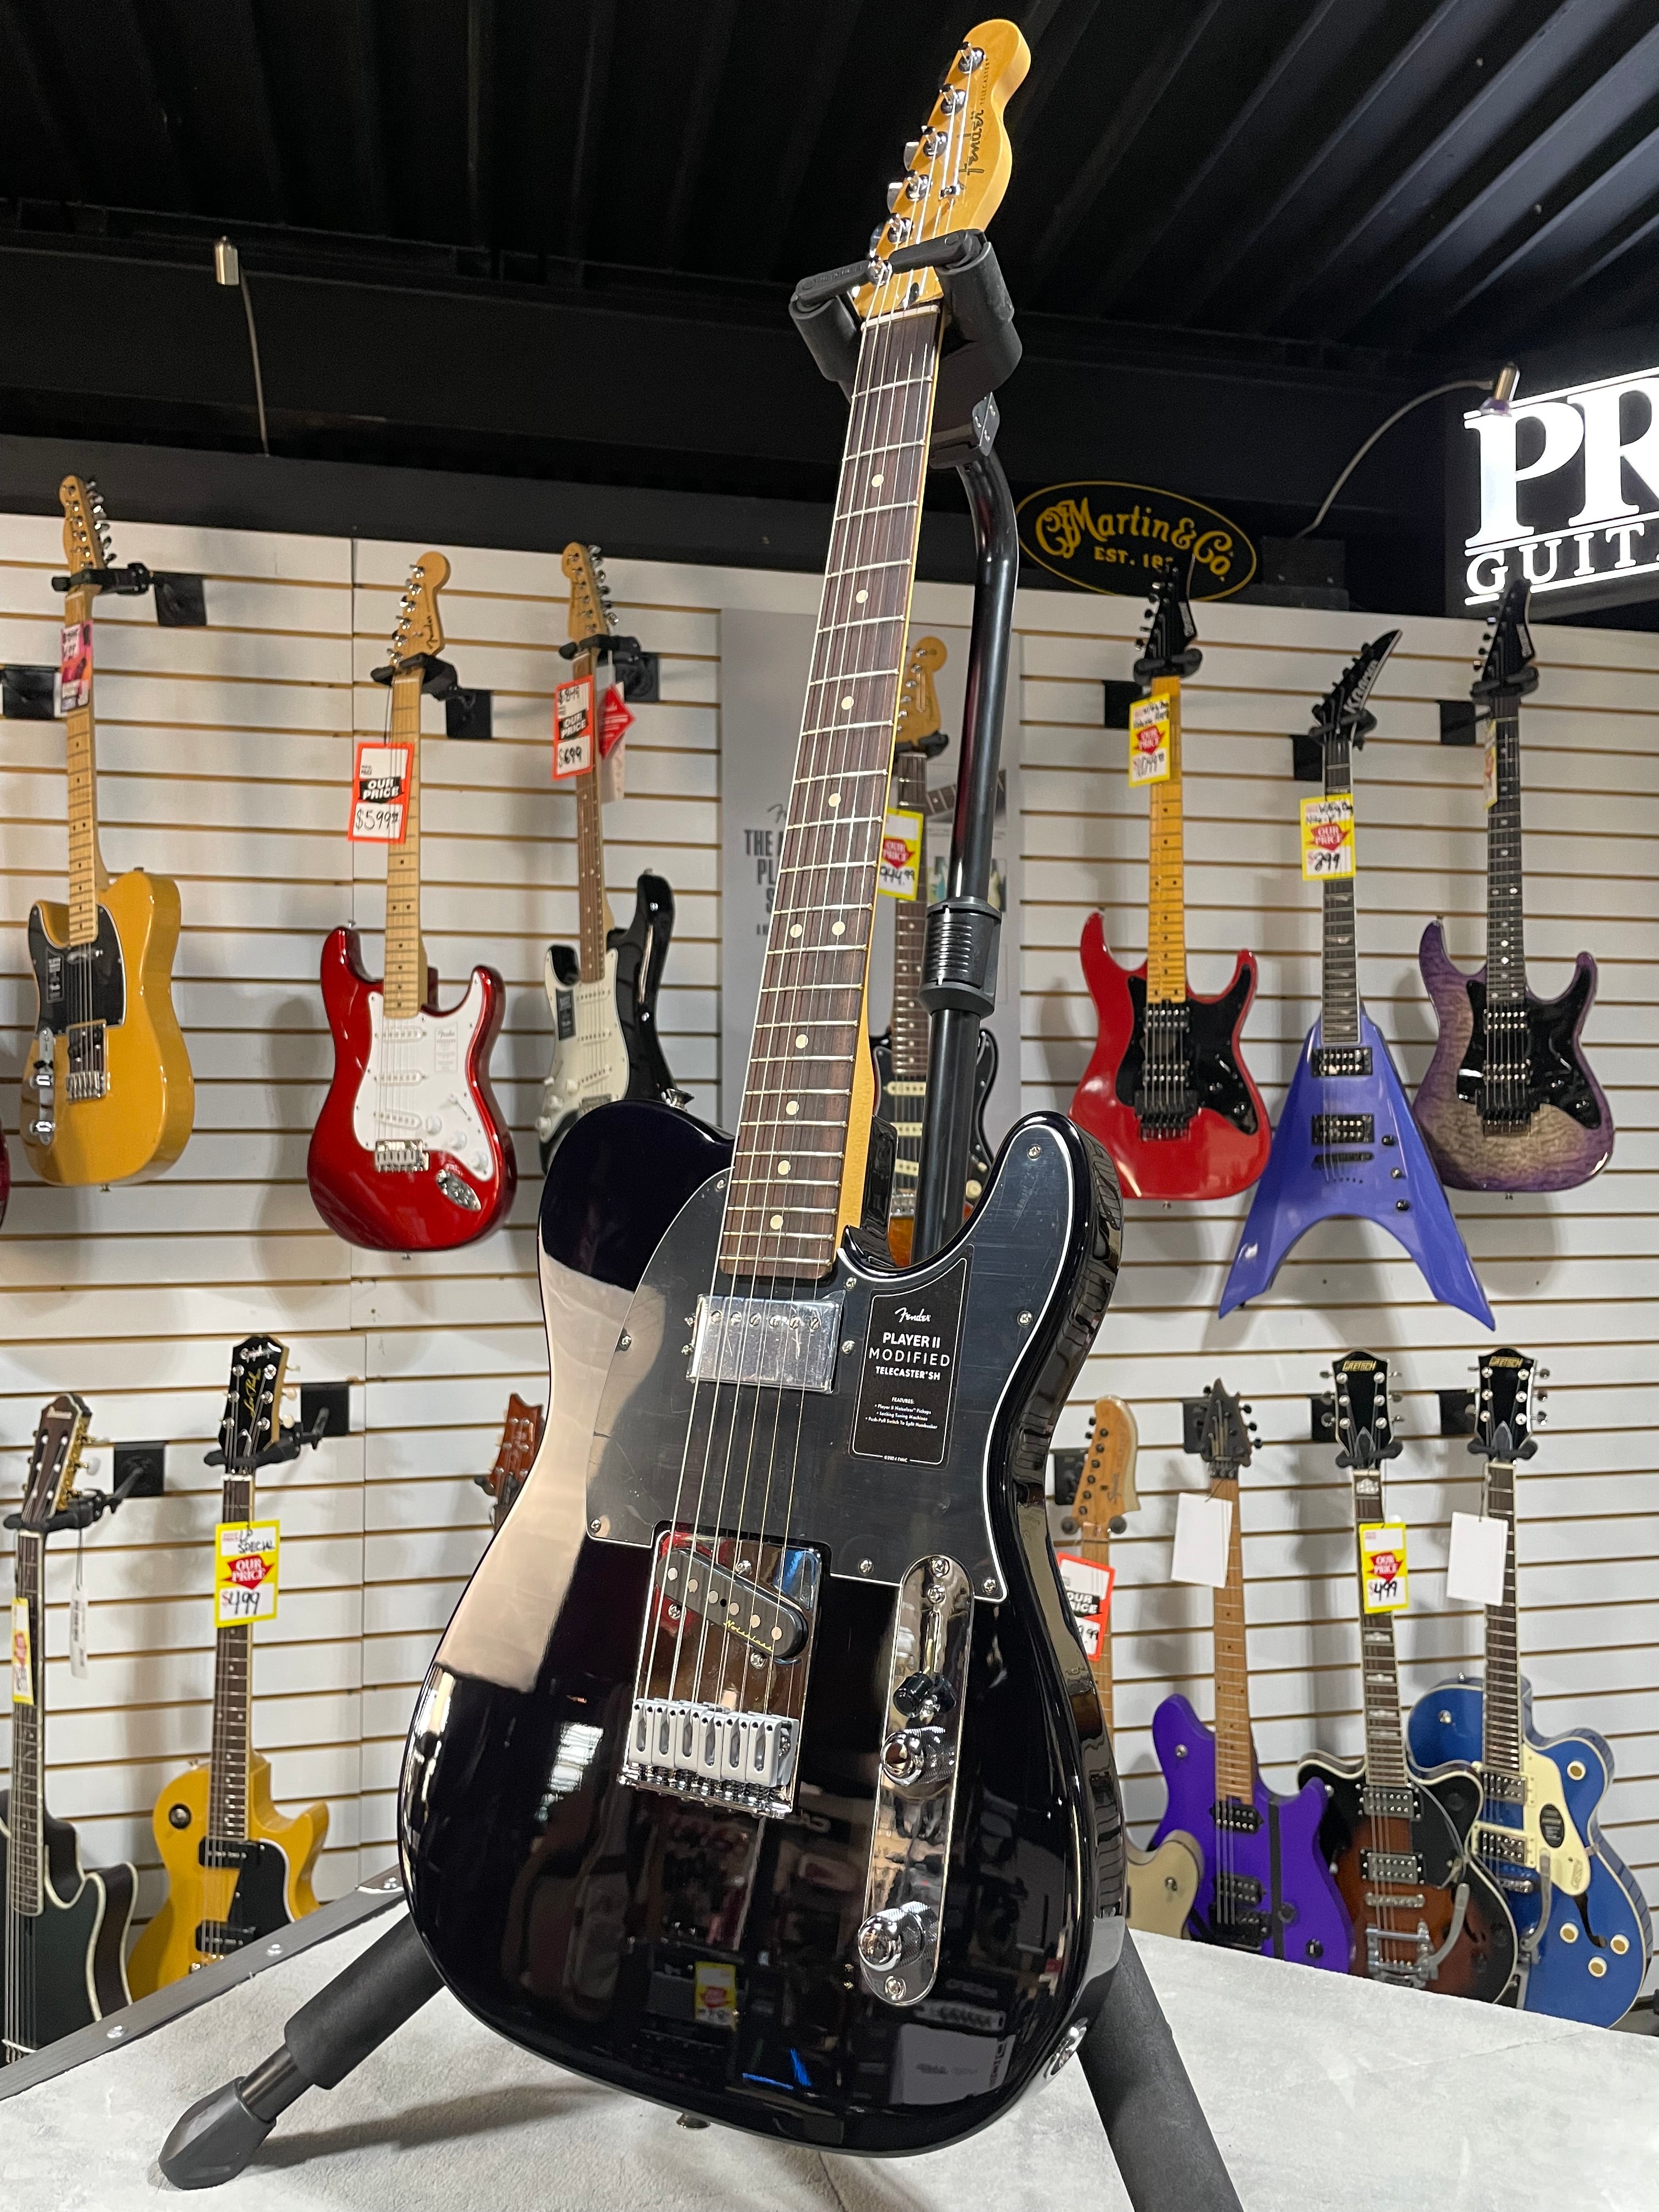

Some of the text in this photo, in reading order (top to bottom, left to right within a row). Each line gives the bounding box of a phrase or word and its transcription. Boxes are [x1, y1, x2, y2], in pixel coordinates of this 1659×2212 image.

[1094, 546, 1135, 566] EST.
[1465, 522, 1659, 596] GUIT
[564, 713, 583, 729] OUR
[561, 720, 586, 738] PRICE
[368, 778, 394, 790] OUR
[363, 786, 399, 800] PRICE
[1315, 833, 1343, 845] PRICE
[1317, 826, 1339, 837] OUR
[744, 829, 774, 856] THE
[885, 840, 906, 851] OUR
[894, 1307, 931, 1323] Fender
[883, 1332, 941, 1348] PLAYER II
[868, 1347, 951, 1367] MODIFIED
[1489, 1356, 1524, 1368] GRETSCH
[1342, 1360, 1377, 1372] GRETSCH
[235, 1558, 262, 1571] OUR
[231, 1567, 267, 1583] PRICE
[1066, 1592, 1093, 1604] OUR
[1070, 1601, 1098, 1615] RICE
[723, 1620, 774, 1652] Noiseless
